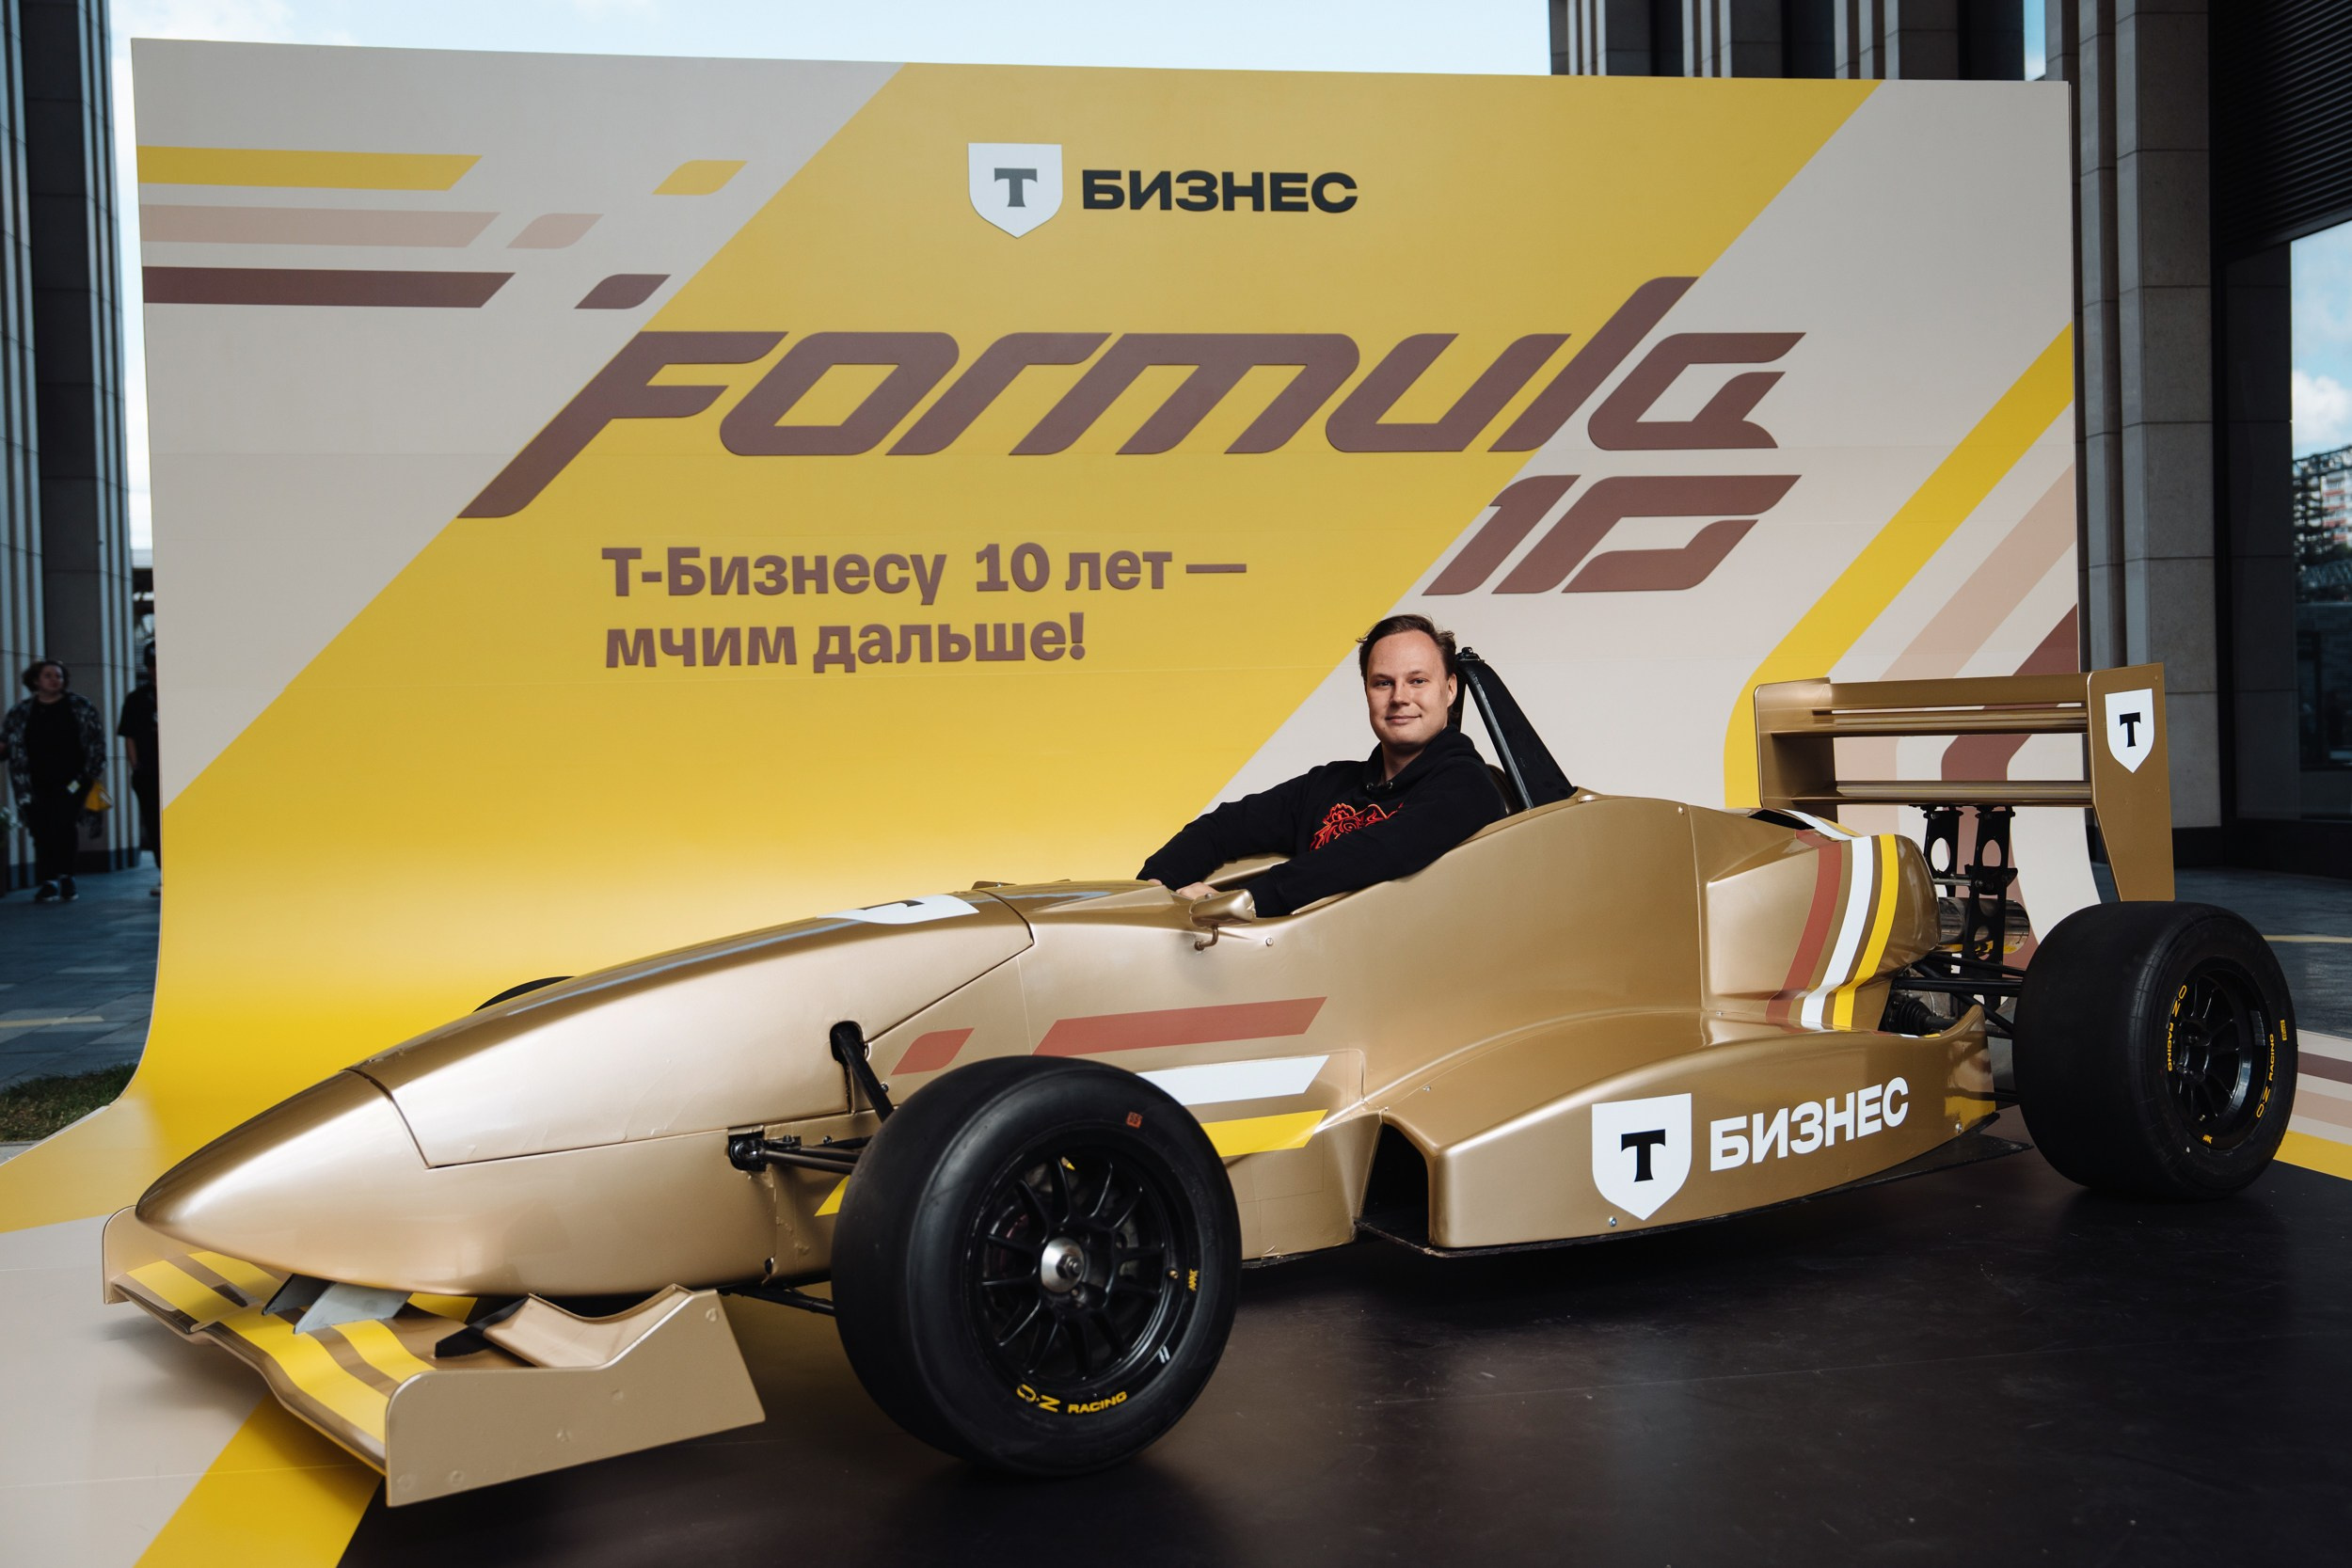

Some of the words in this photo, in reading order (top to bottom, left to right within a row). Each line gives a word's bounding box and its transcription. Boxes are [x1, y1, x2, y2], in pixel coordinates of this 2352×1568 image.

[1082, 169, 1359, 214] БИЗНЕС
[601, 546, 947, 606] Т-Бизнесу
[976, 542, 1050, 593] 10
[1065, 550, 1172, 591] лет
[606, 626, 798, 669] мчим
[813, 611, 1086, 673] дальше!
[1709, 1076, 1909, 1172] БИЗНЕС
[1068, 1391, 1128, 1414] RACING
